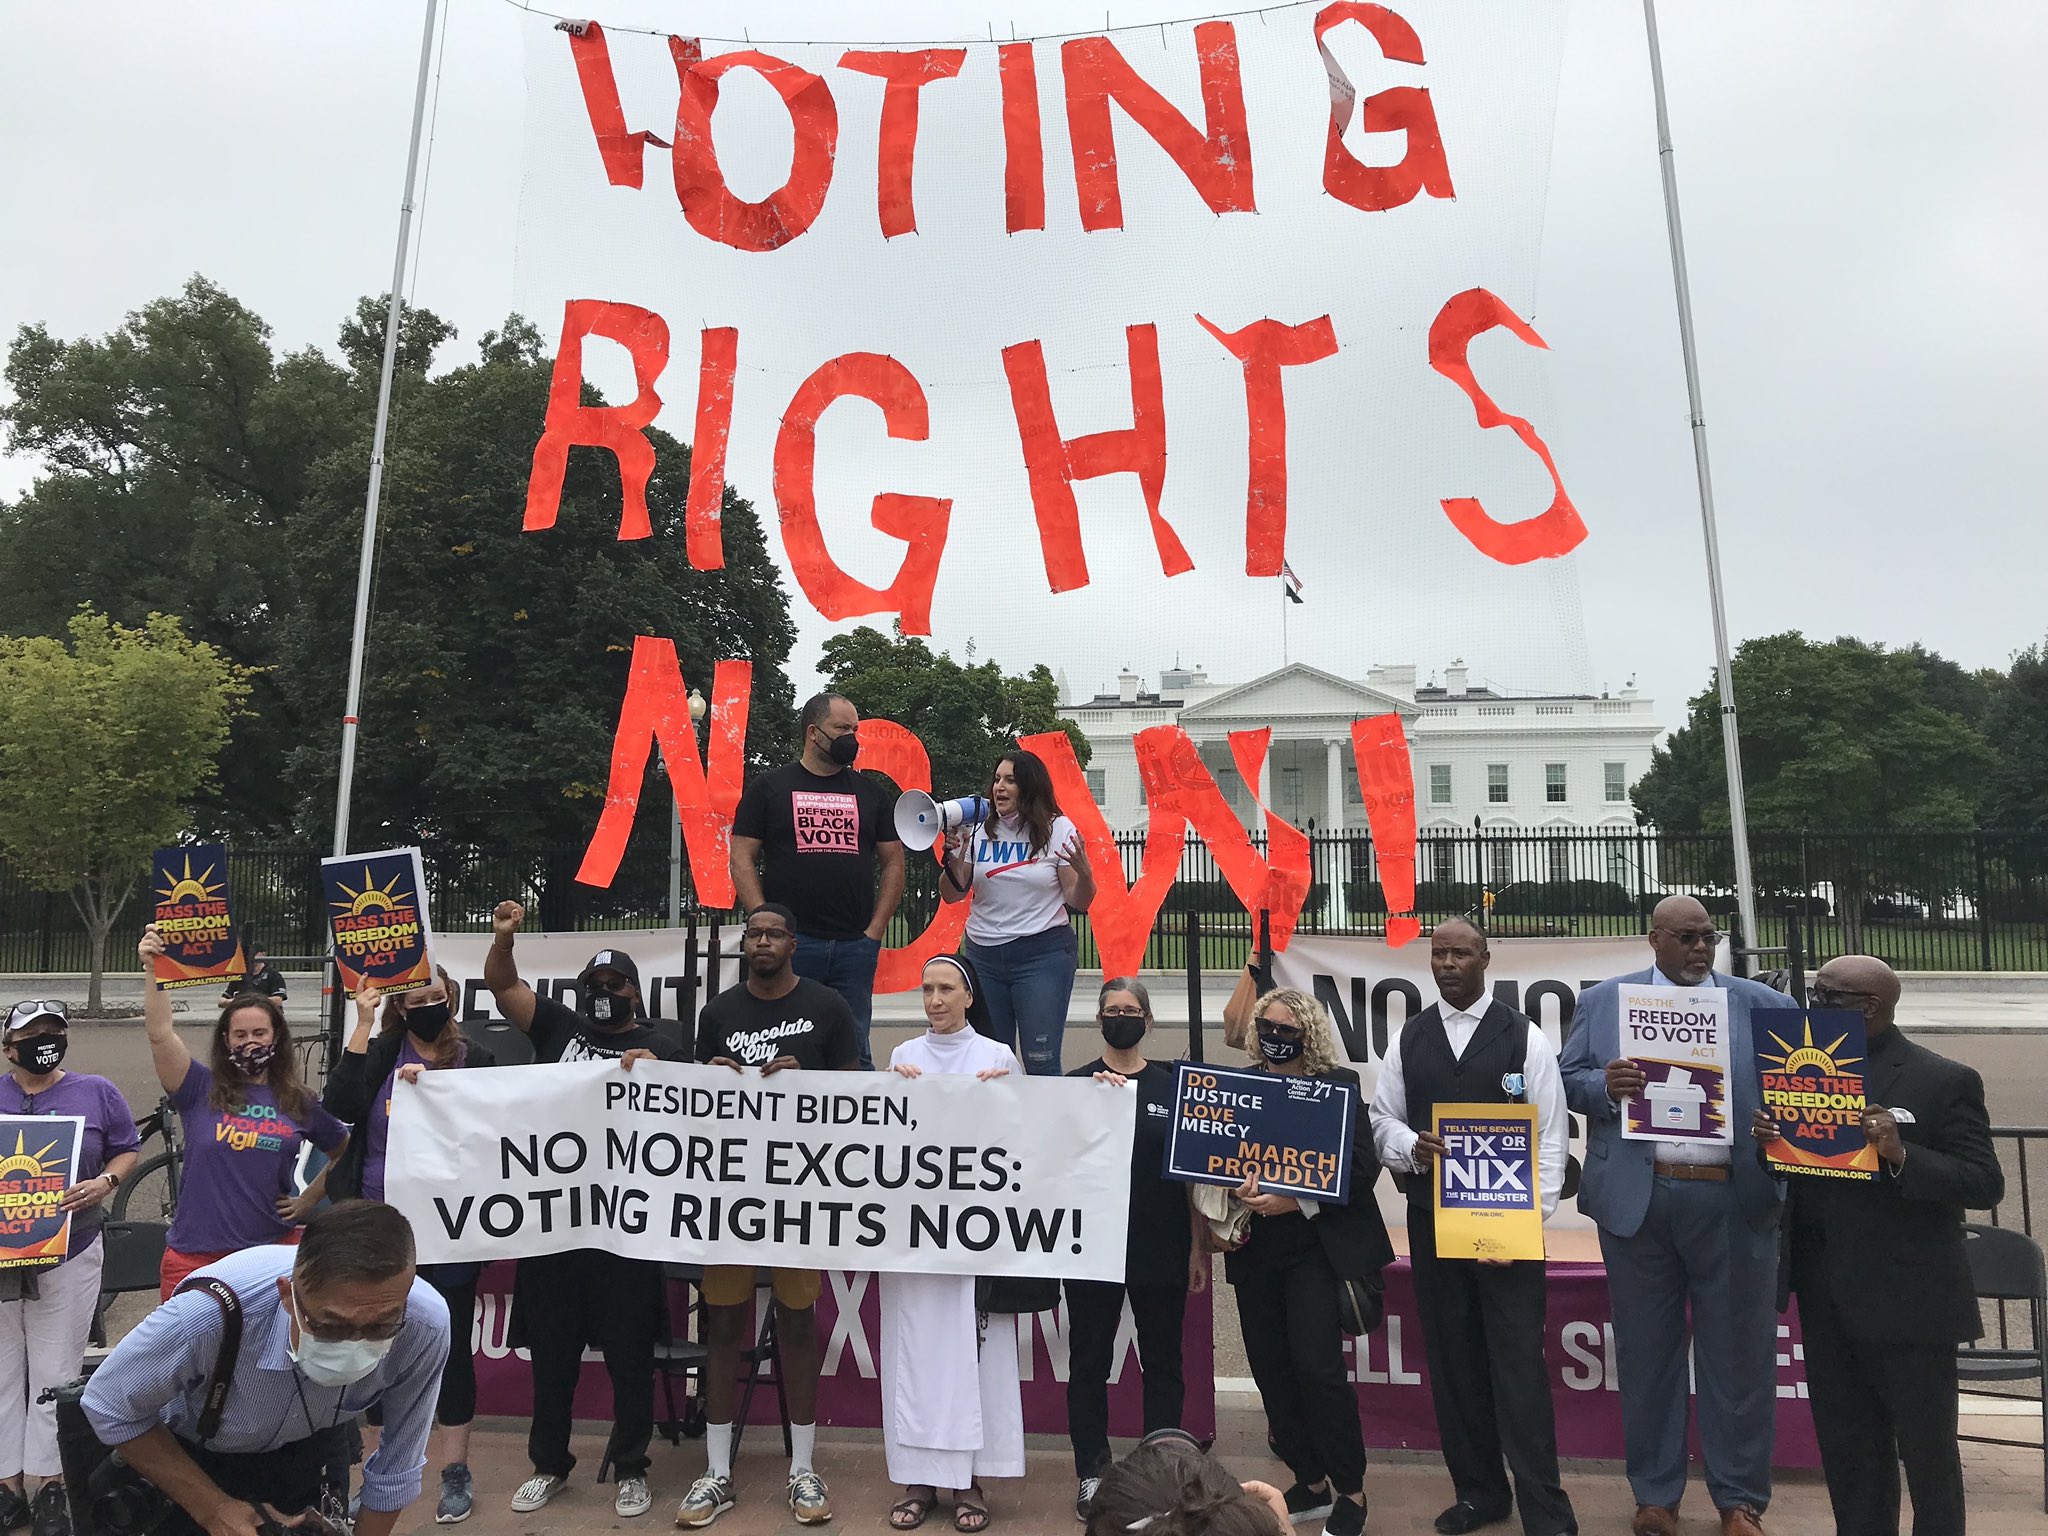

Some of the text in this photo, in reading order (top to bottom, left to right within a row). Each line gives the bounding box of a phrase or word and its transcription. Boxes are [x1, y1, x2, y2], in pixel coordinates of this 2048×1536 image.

[567, 2, 1455, 252] VOTING
[523, 287, 1588, 637] RIGHTS
[797, 801, 855, 809] SUPPRESSION
[798, 808, 844, 816] DEFEND
[798, 816, 854, 830] BLACK
[800, 830, 856, 846] VOTE
[977, 838, 1030, 863] LWV
[156, 901, 228, 919] PASS THE
[155, 914, 231, 933] FREEDOM
[334, 909, 416, 932] PASS THE
[160, 927, 229, 945] TO VOTE
[336, 921, 419, 945] FREEDOM
[182, 943, 213, 956] ACT
[342, 936, 415, 957] TO VOTE
[364, 951, 397, 967] ACT
[163, 974, 243, 990] DFADCOALITION.ORG
[1629, 997, 1675, 1008] PASS THE
[1629, 1009, 1717, 1027] FREEDOM
[726, 1018, 814, 1053] Chocolate
[1630, 1025, 1717, 1045] TO VOTE
[35, 1052, 60, 1065] VOTE!
[740, 1043, 780, 1064] City
[1691, 1047, 1717, 1058] ACT
[1187, 1072, 1217, 1089] DO
[1285, 1077, 1313, 1086] Religious
[1292, 1084, 1311, 1092] Action
[1762, 1074, 1864, 1094] PASS THE
[605, 1082, 918, 1131] PRESIDENT BIDEN,
[1182, 1086, 1263, 1111] JUSTICE
[1763, 1089, 1867, 1110] FREEDOM
[1183, 1102, 1234, 1123] LOVE
[1771, 1105, 1861, 1126] TO VOTE
[216, 1122, 259, 1151] Vigil
[1181, 1117, 1251, 1139] MERCY
[1469, 1125, 1488, 1133] THE
[1795, 1123, 1838, 1140] ACT
[1444, 1135, 1526, 1157] FIX OR
[501, 1128, 1023, 1192] NO MORE EXCUSES:
[1238, 1141, 1337, 1172] MARCH
[1207, 1155, 1335, 1190] PROUDLY
[1445, 1158, 1528, 1190] NIX
[1774, 1163, 1872, 1180] DFADCOALITION.ORG
[0, 1177, 64, 1193] SS THE
[1460, 1191, 1528, 1202] FILIBUSTER
[3, 1204, 57, 1220] VOTE
[433, 1183, 1083, 1255] VOTING RIGHTS NOW!
[0, 1256, 59, 1269] ALITION.ORG
[209, 1282, 235, 1311] Canon
